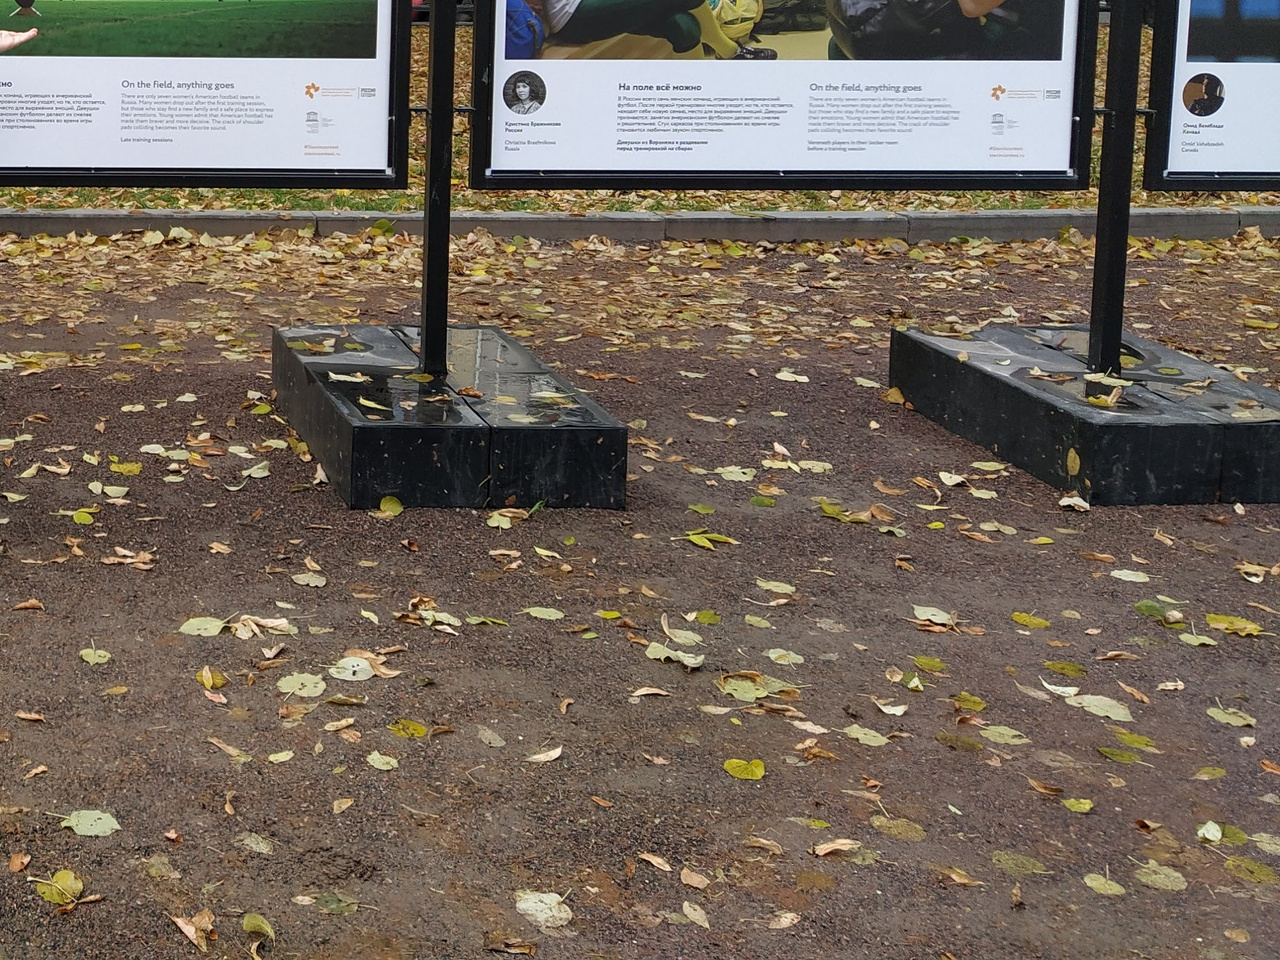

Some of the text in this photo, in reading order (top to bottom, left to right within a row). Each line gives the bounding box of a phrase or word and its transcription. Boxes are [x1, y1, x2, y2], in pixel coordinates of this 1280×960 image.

[121, 80, 235, 91] On the field, anything goes
[618, 83, 631, 91] На
[656, 83, 671, 91] всё
[809, 83, 824, 91] On
[825, 83, 840, 91] the
[841, 83, 863, 93] field,
[864, 83, 901, 93] anything
[132, 136, 151, 144] training
